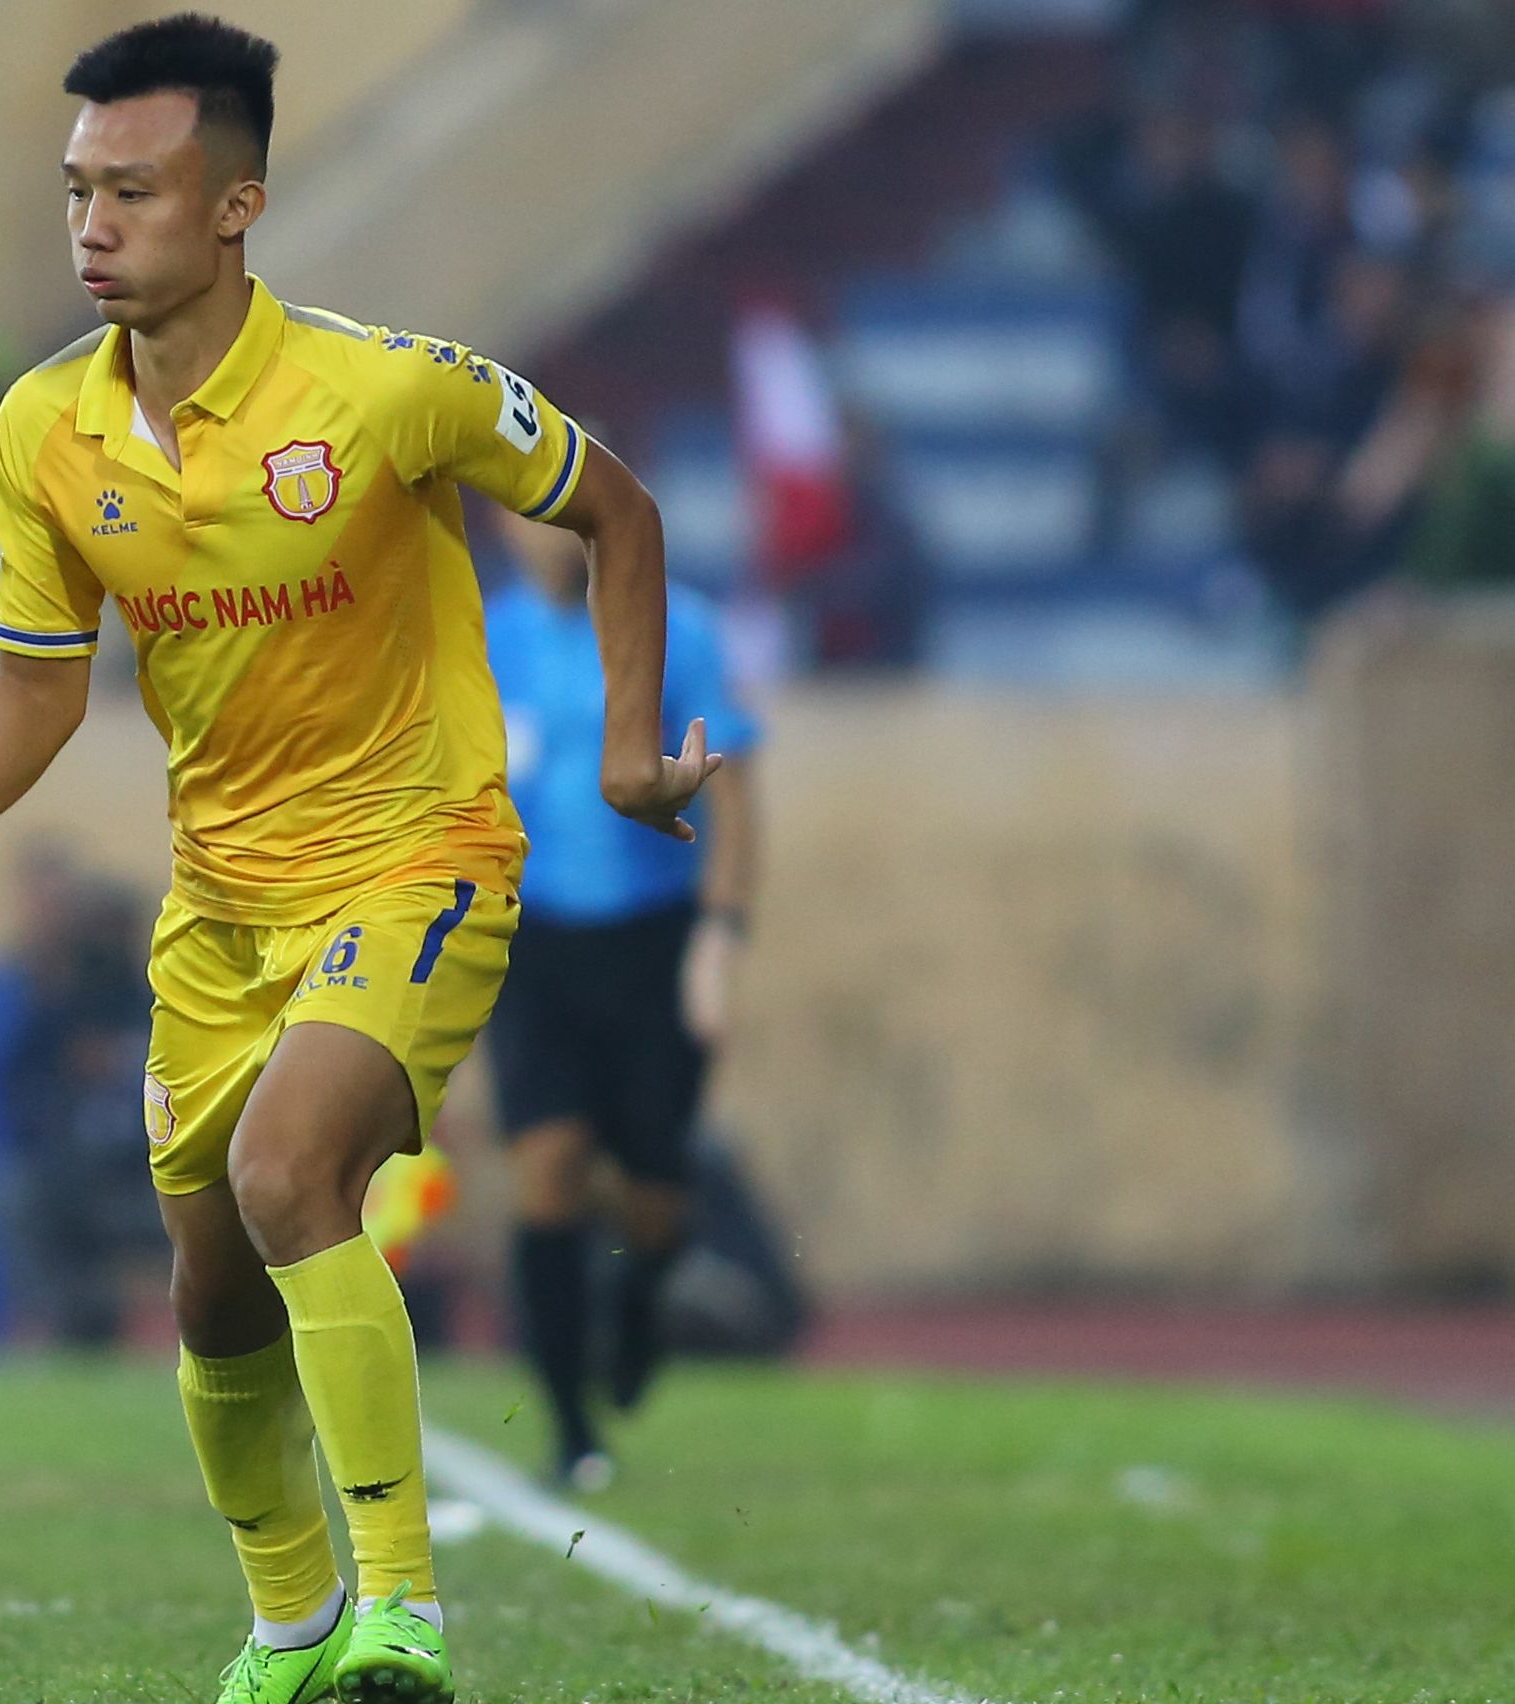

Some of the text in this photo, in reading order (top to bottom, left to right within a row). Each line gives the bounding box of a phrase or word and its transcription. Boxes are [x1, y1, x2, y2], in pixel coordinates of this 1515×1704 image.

[91, 521, 138, 536] KELME
[211, 582, 293, 629] NAM
[300, 559, 356, 618] HÀ
